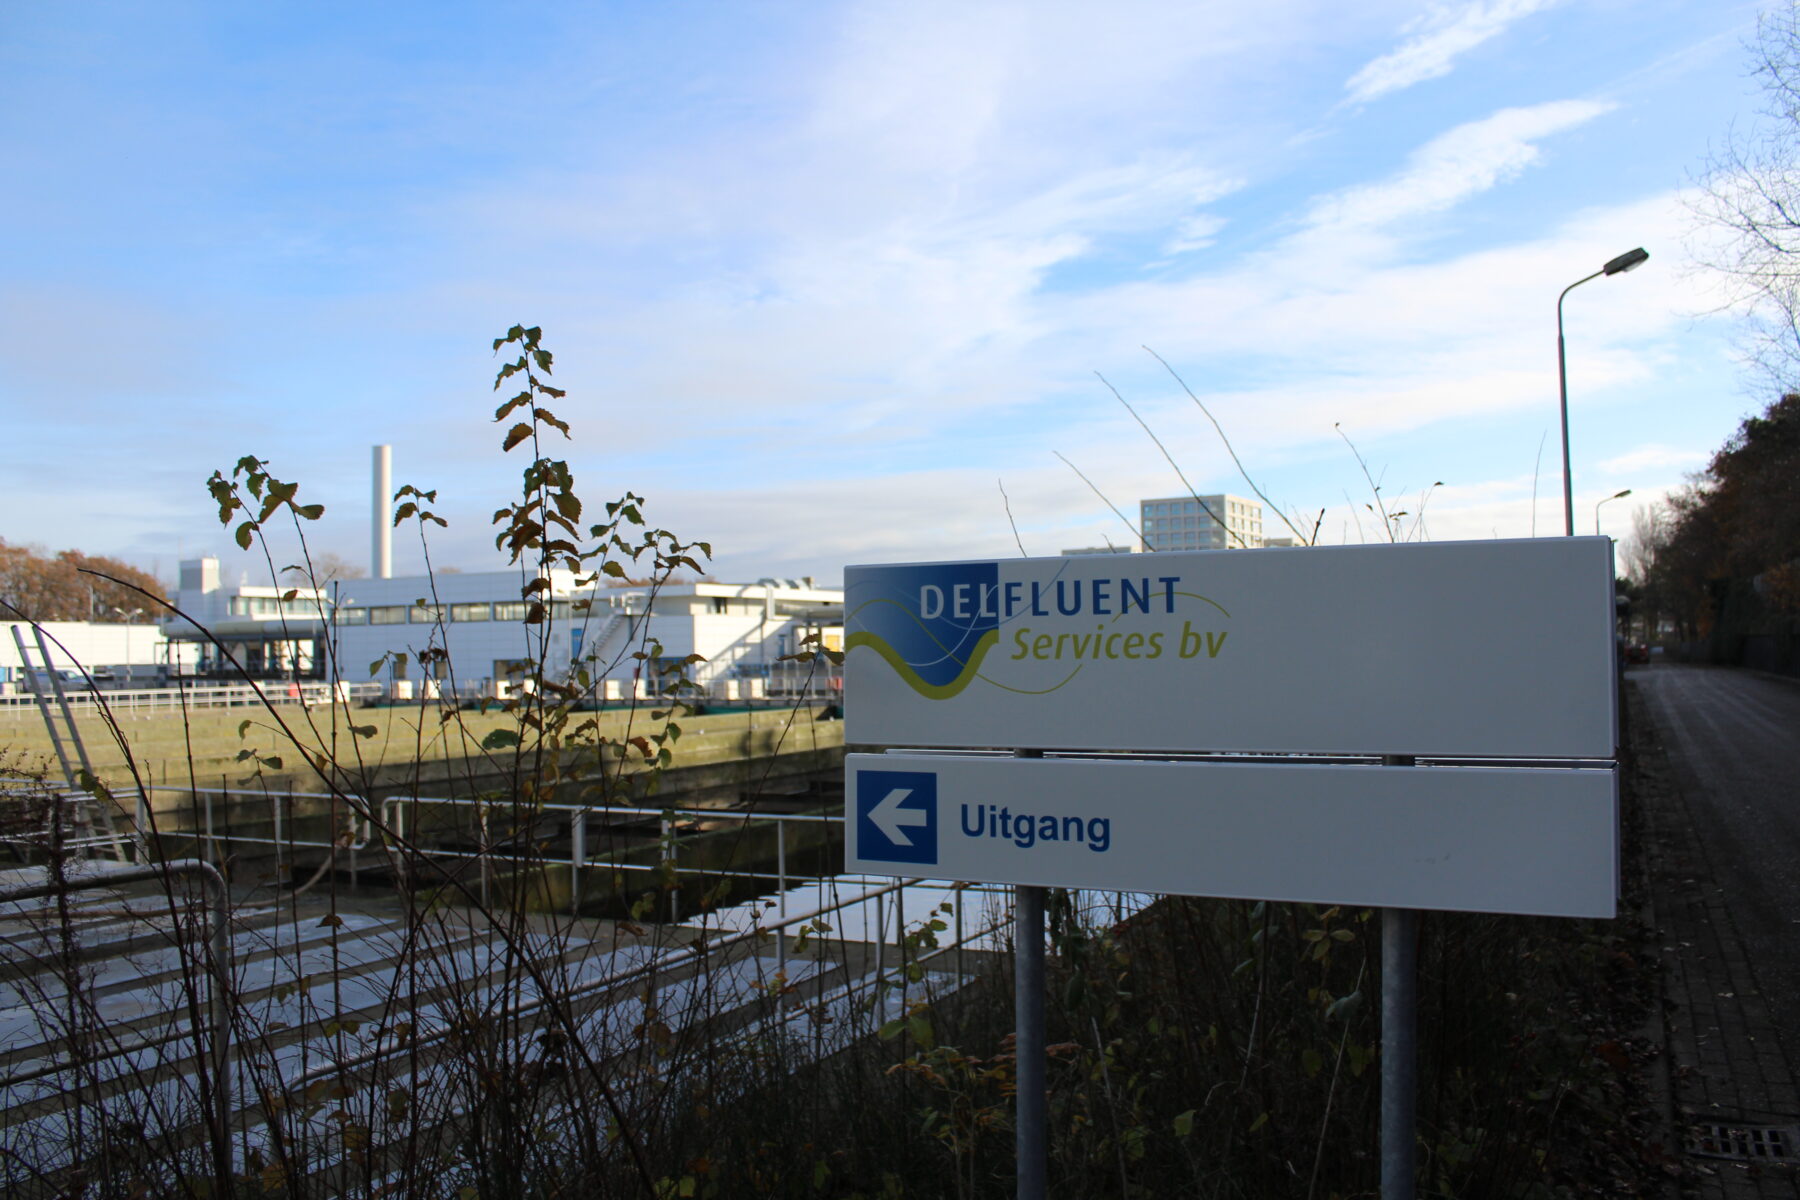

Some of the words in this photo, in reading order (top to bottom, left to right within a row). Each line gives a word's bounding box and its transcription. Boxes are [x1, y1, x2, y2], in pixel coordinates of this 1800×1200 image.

[920, 576, 1181, 620] DELFLUENT
[1010, 624, 1165, 661] Services
[1178, 620, 1229, 660] bv
[960, 803, 1111, 853] Uitgang
